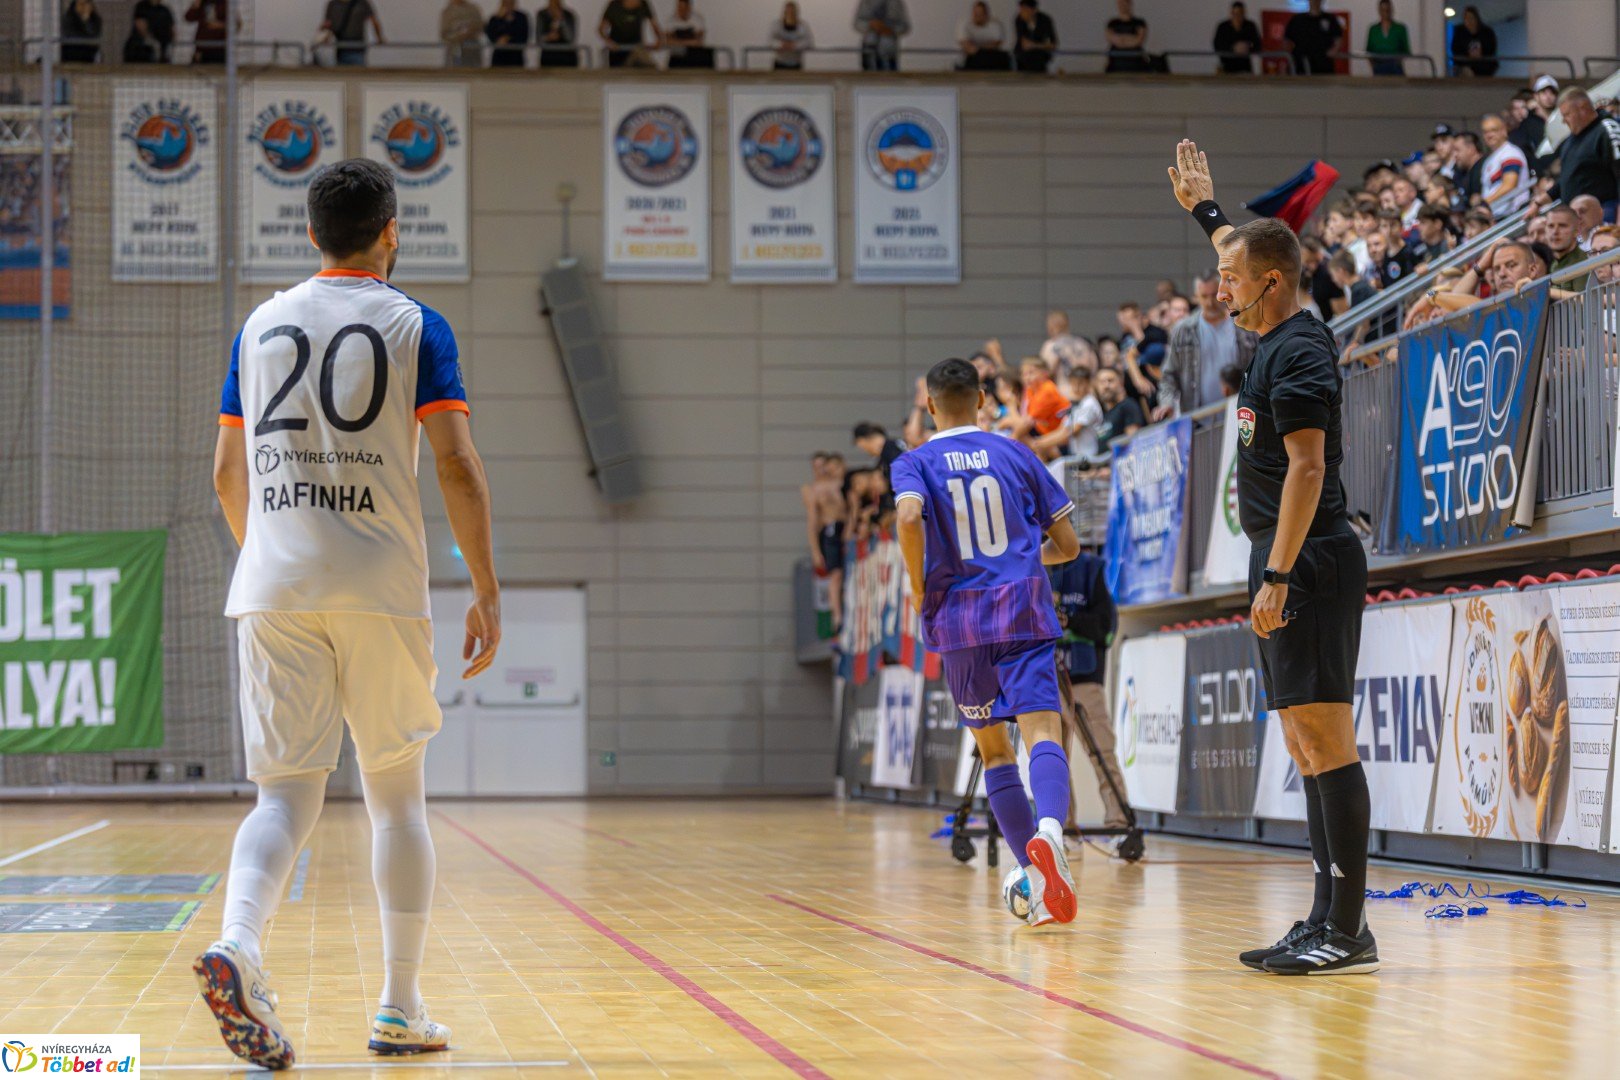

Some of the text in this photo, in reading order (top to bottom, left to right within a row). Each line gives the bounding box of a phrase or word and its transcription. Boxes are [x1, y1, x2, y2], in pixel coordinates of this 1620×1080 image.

[254, 323, 388, 437] 20
[284, 448, 384, 466] NYÍREGYHÁZA
[944, 449, 990, 472] THIAGO
[263, 481, 376, 514] RAFINHA
[947, 474, 1009, 561] 10
[0, 657, 117, 730] LYA!
[1469, 701, 1495, 734] VEKNI
